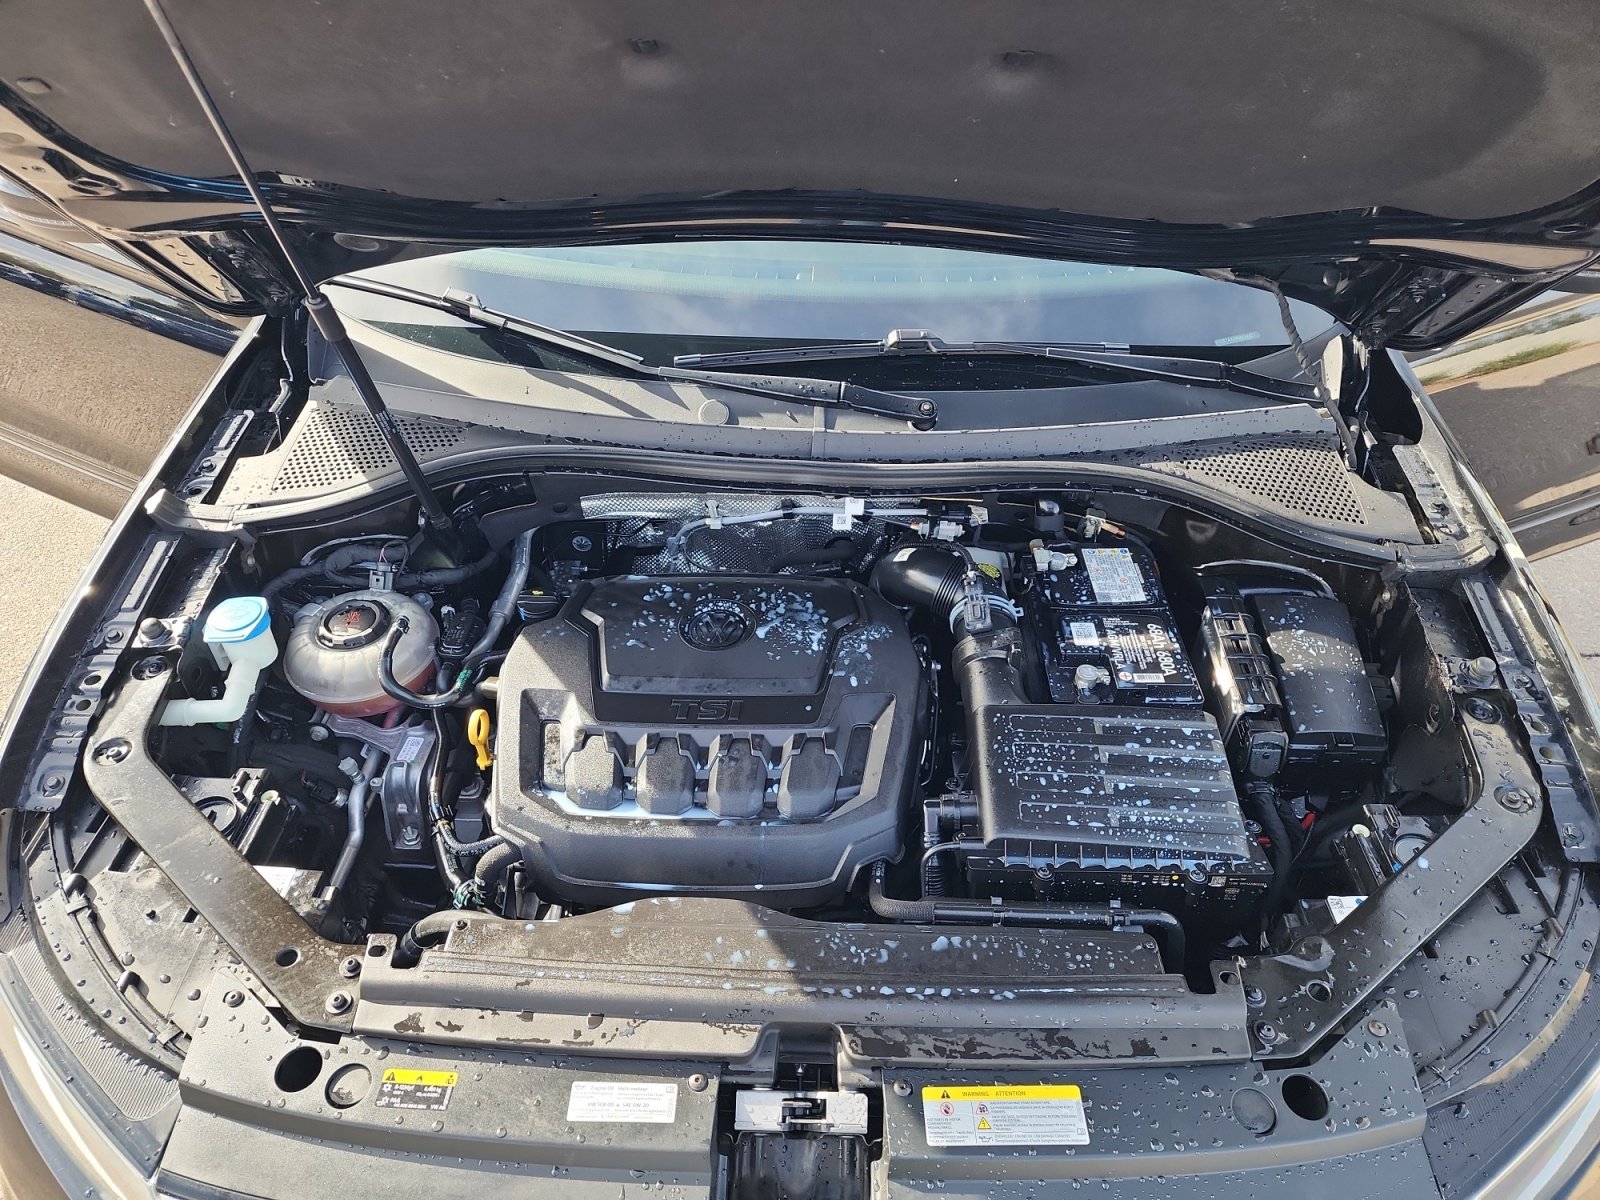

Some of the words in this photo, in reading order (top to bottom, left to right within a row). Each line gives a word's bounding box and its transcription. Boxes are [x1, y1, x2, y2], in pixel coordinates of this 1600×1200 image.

[1147, 623, 1165, 651] 68Ah
[1156, 651, 1177, 677] 680A
[671, 699, 743, 720] TSI
